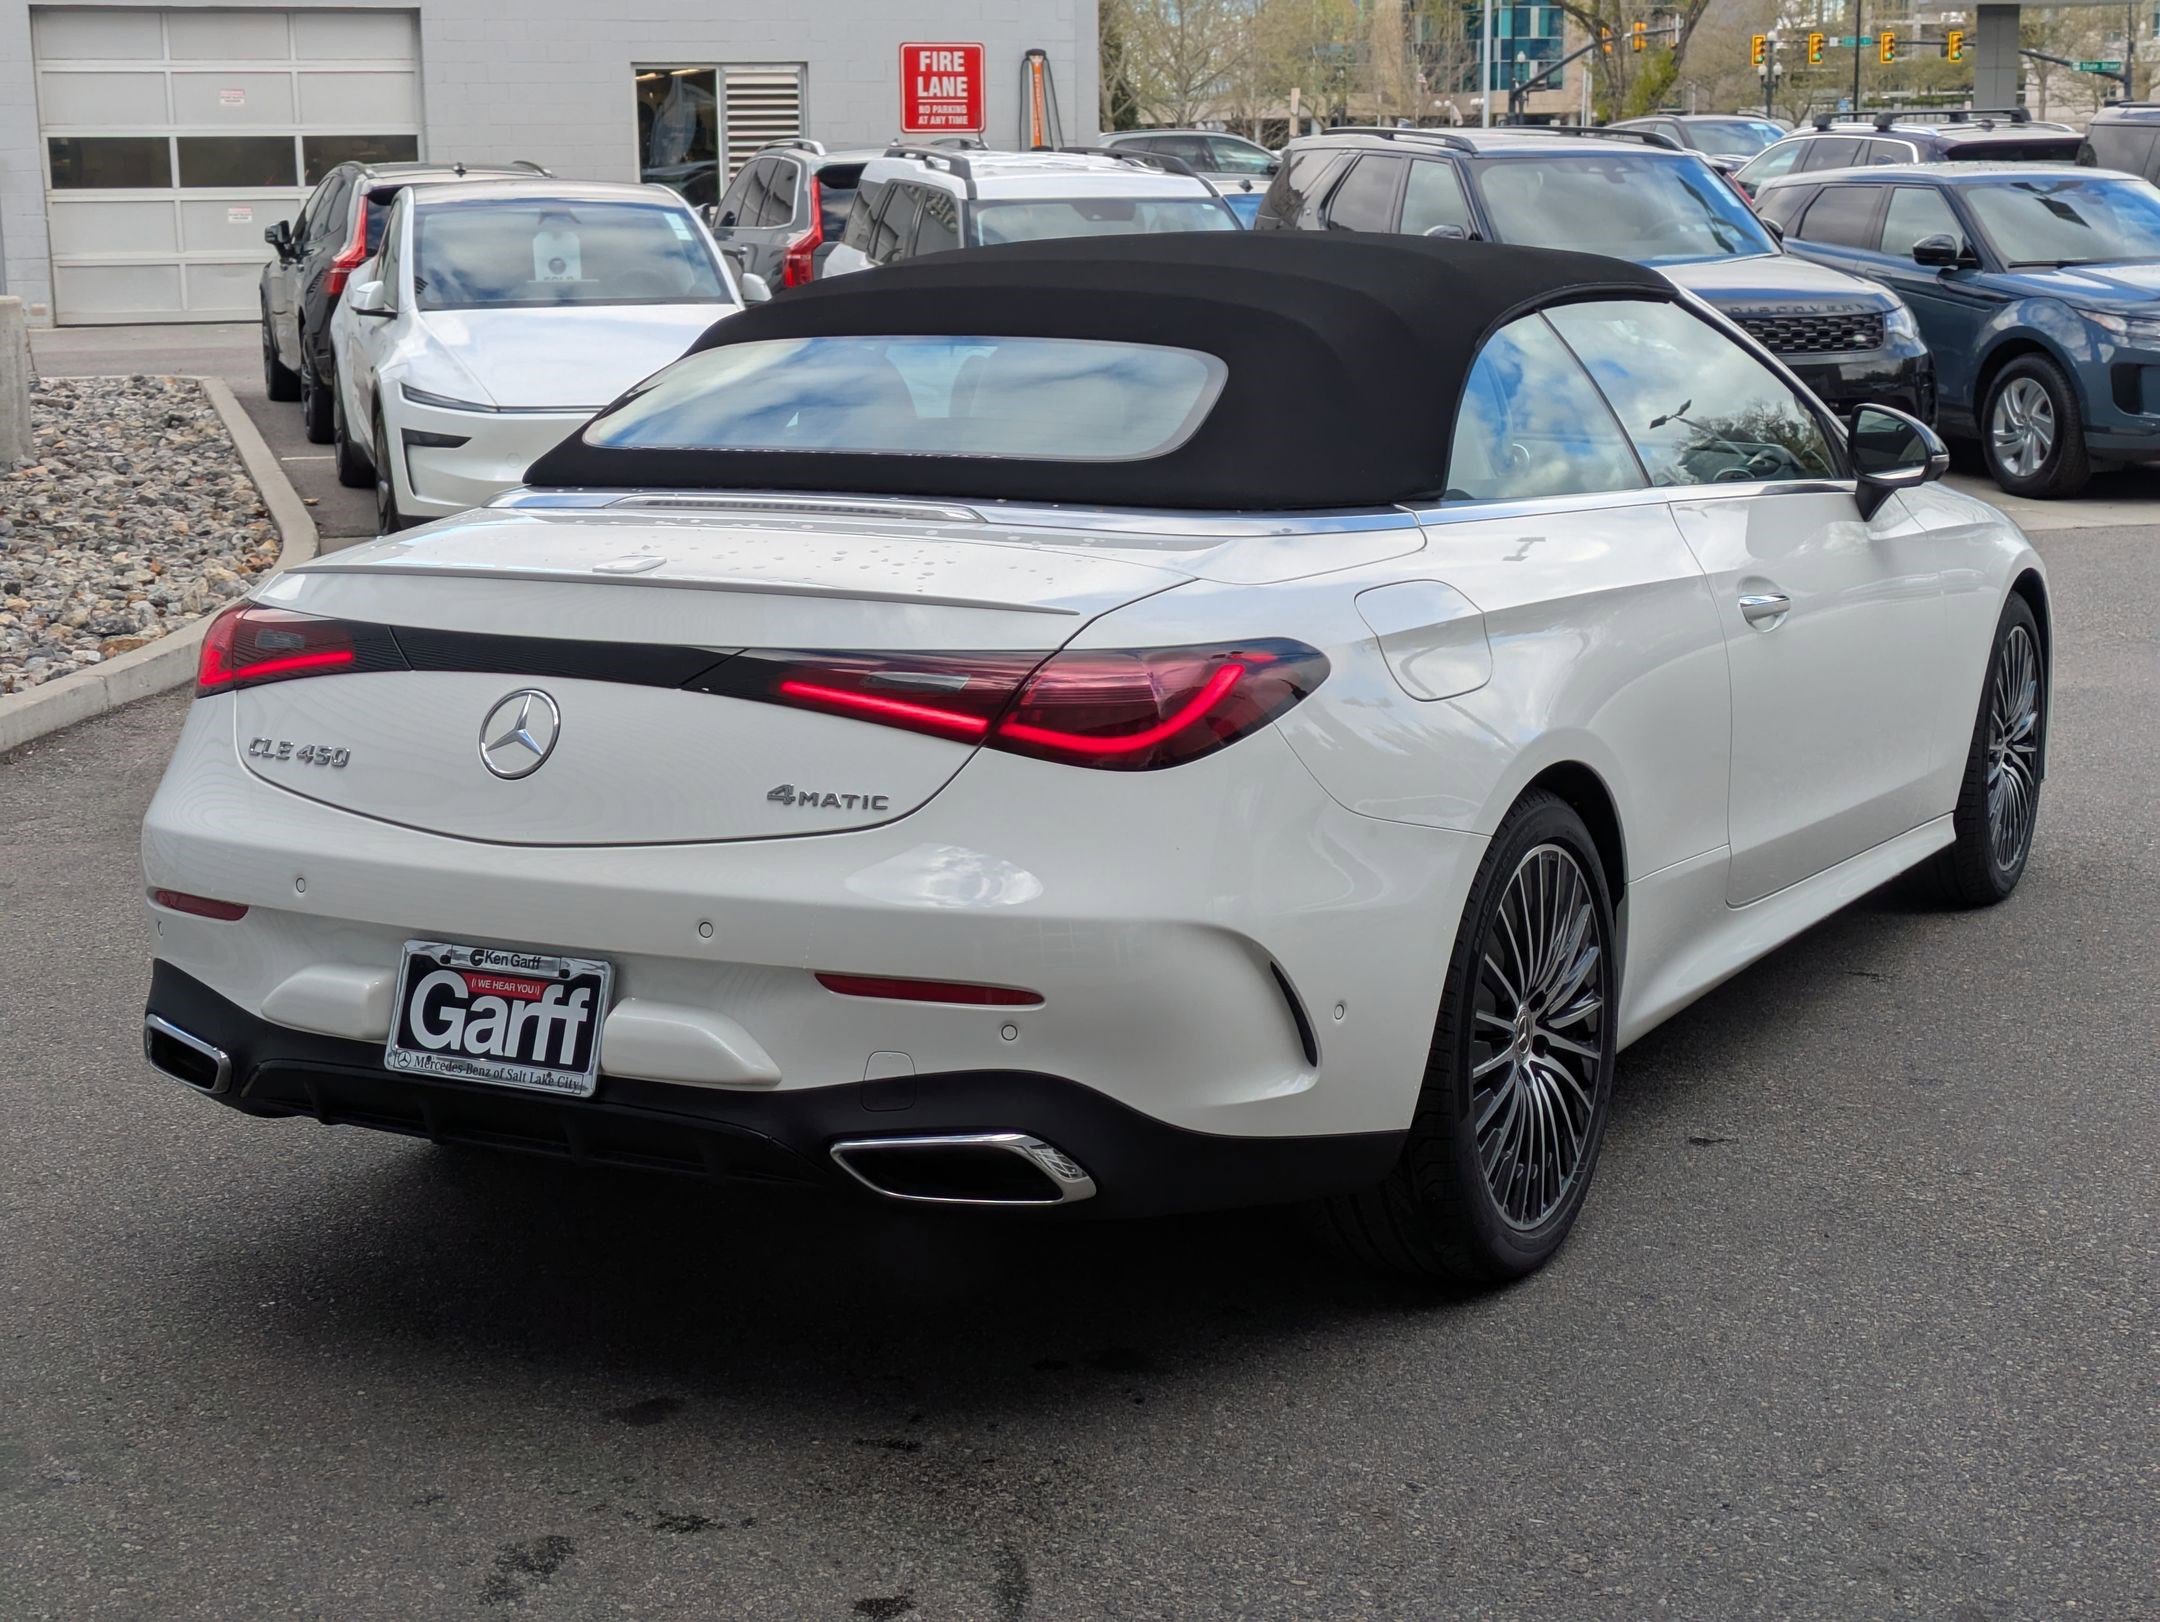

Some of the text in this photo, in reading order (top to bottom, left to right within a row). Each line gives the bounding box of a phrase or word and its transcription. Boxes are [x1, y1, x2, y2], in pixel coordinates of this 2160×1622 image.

[919, 51, 965, 72] FIRE
[917, 76, 968, 97] LANE
[918, 105, 967, 114] NO PARKING
[918, 116, 968, 125] AT ANY TIME
[249, 738, 351, 769] CLE 450
[767, 783, 889, 811] 4MATIC
[485, 950, 508, 967] Ken
[510, 954, 541, 970] Garff
[492, 981, 516, 992] HEAR
[517, 984, 534, 994] YOU
[410, 969, 591, 1066] Garff
[414, 1055, 580, 1093] Mercedes-Benz of Salt Lake City
